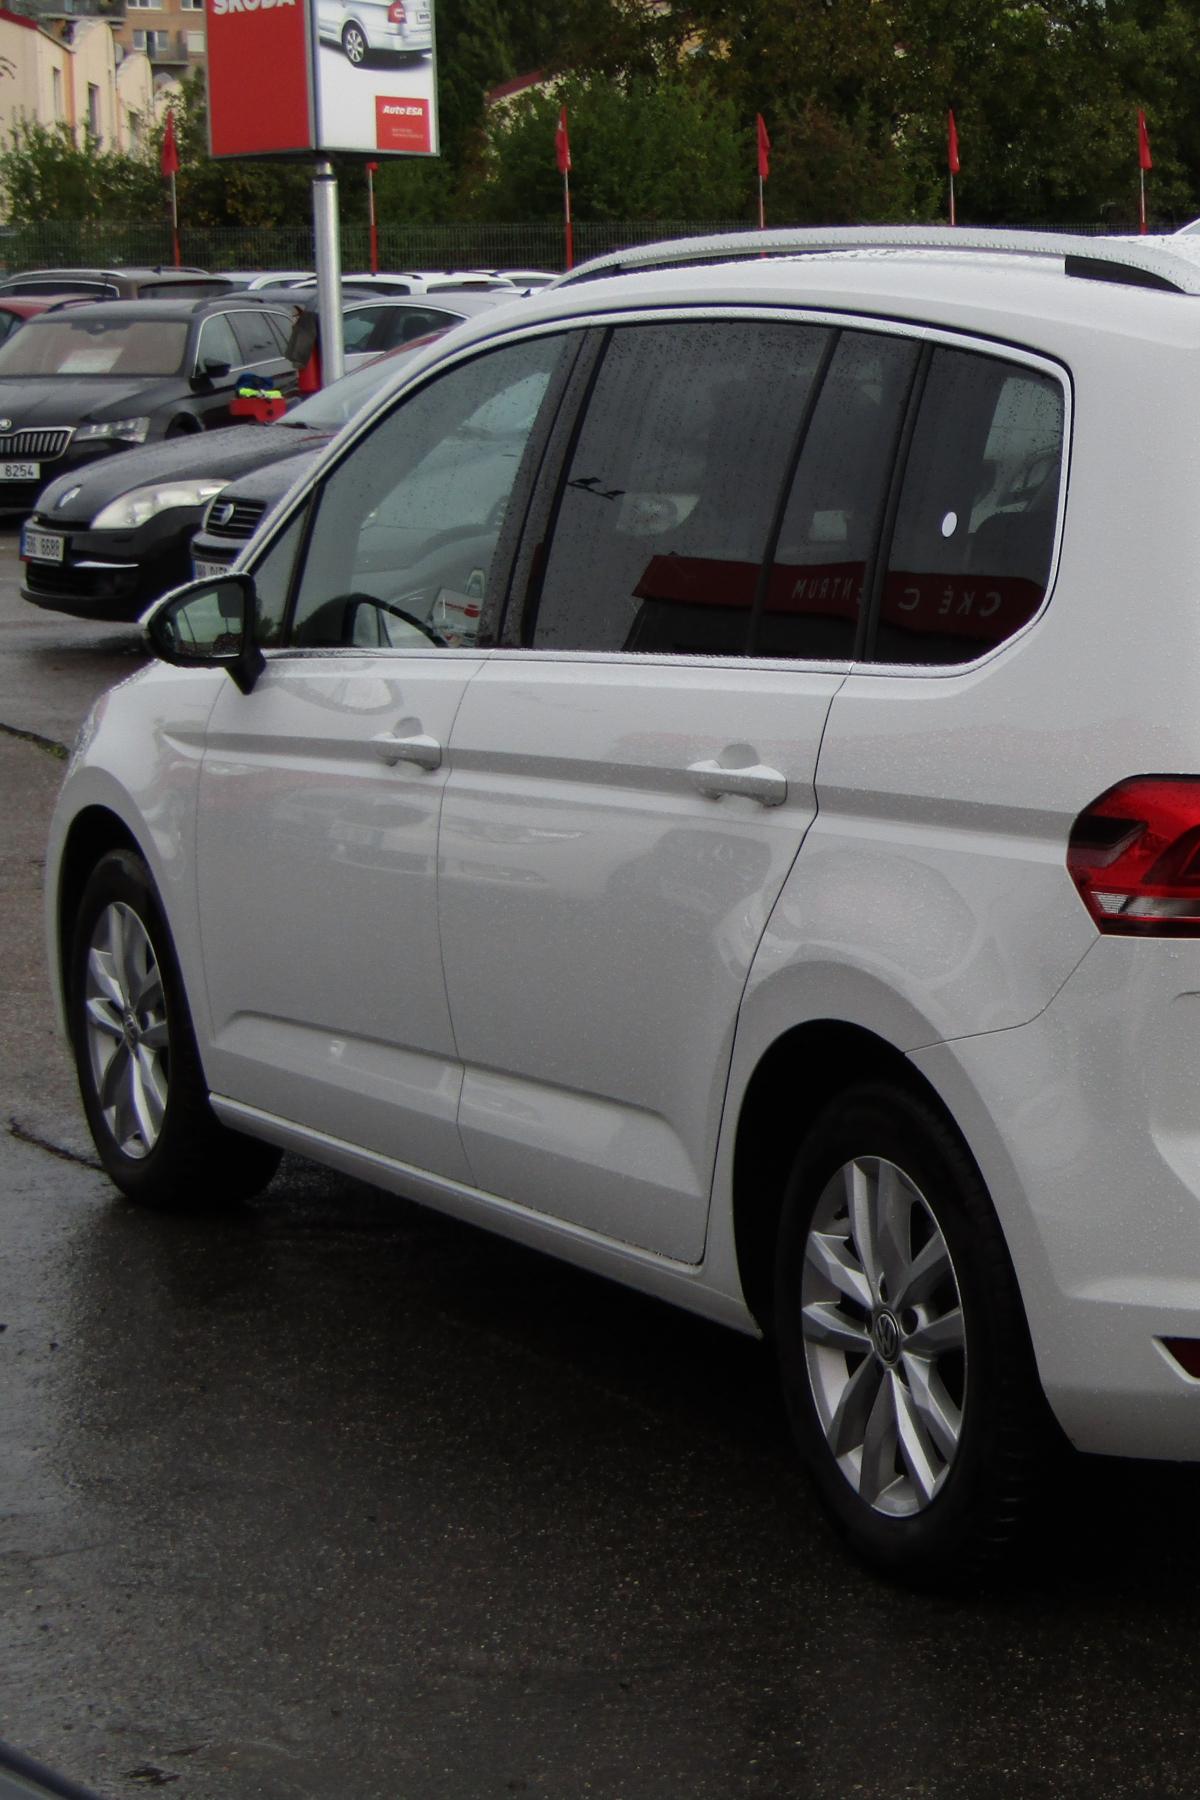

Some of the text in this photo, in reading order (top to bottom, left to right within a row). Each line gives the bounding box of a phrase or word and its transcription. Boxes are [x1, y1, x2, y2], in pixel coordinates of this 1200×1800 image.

[383, 105, 423, 116] Auto ESA
[5, 464, 34, 478] 8254
